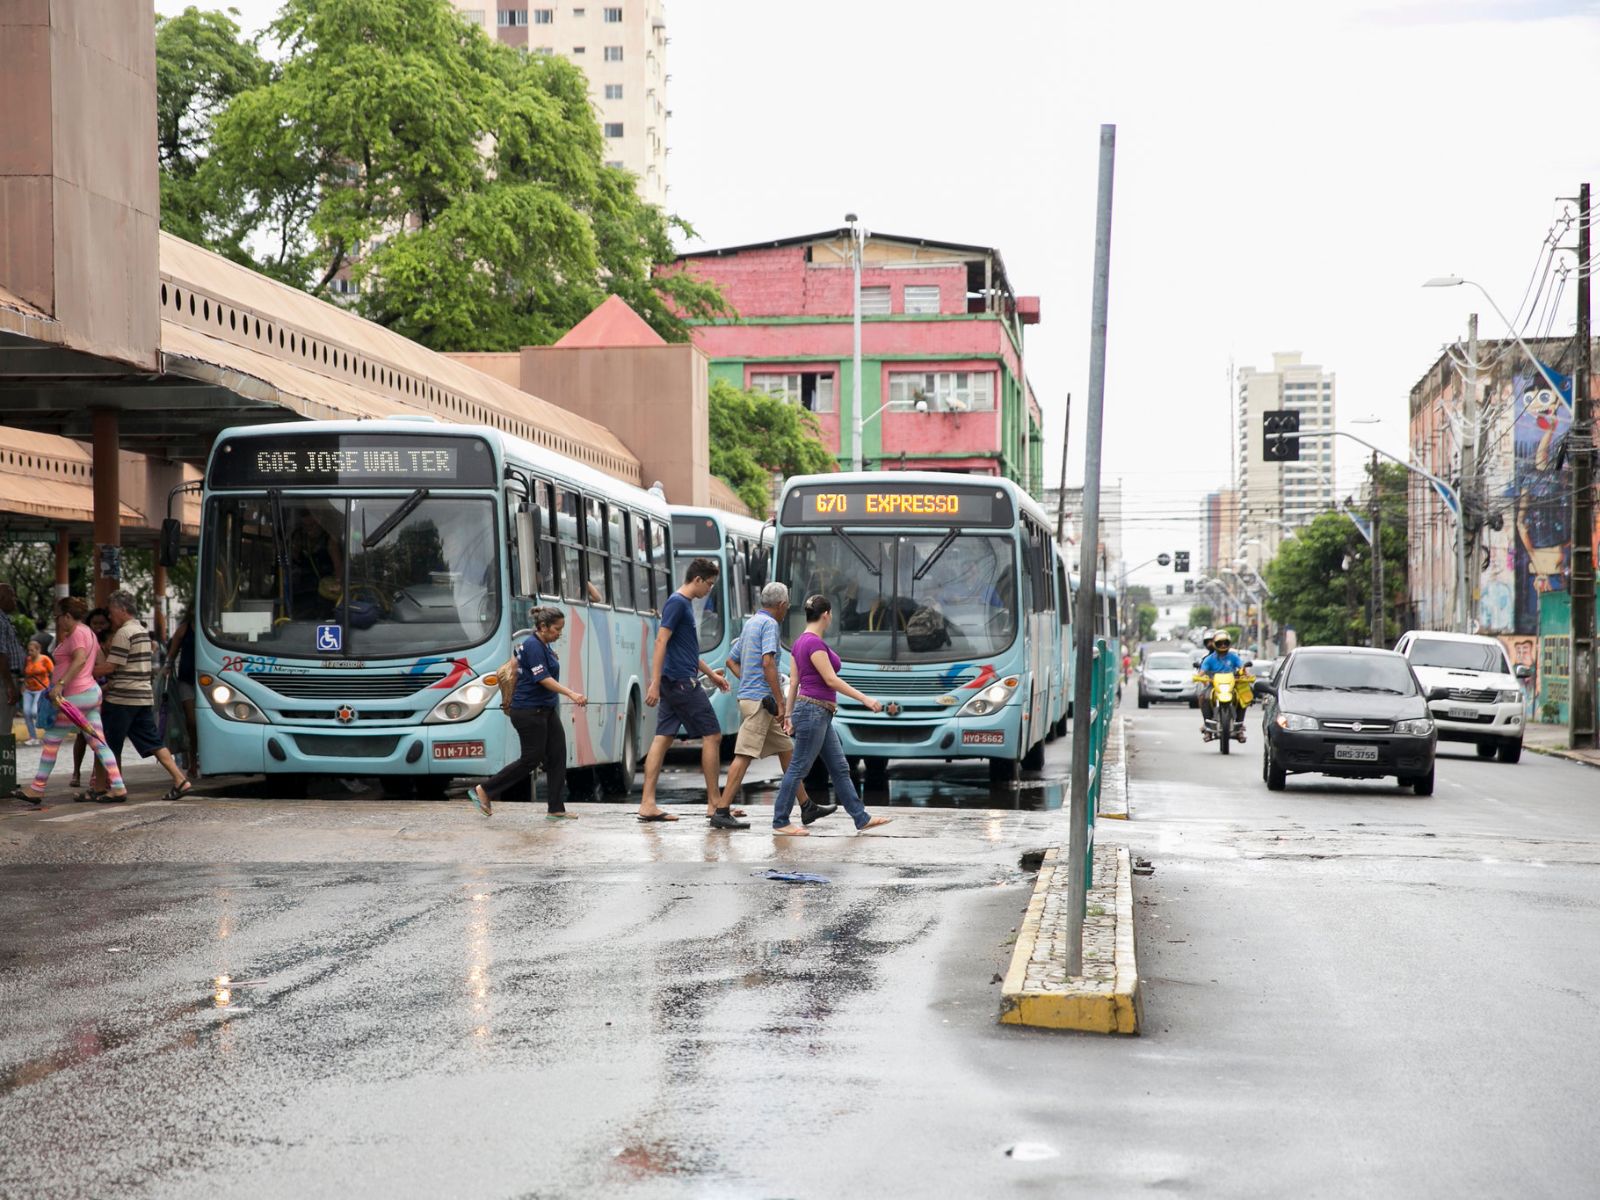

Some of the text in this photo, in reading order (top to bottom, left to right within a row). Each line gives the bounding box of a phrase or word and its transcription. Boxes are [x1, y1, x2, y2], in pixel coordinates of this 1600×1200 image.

[258, 451, 298, 473] 605
[305, 451, 360, 473] JOSE
[815, 493, 960, 513] 670 EXPRESSO
